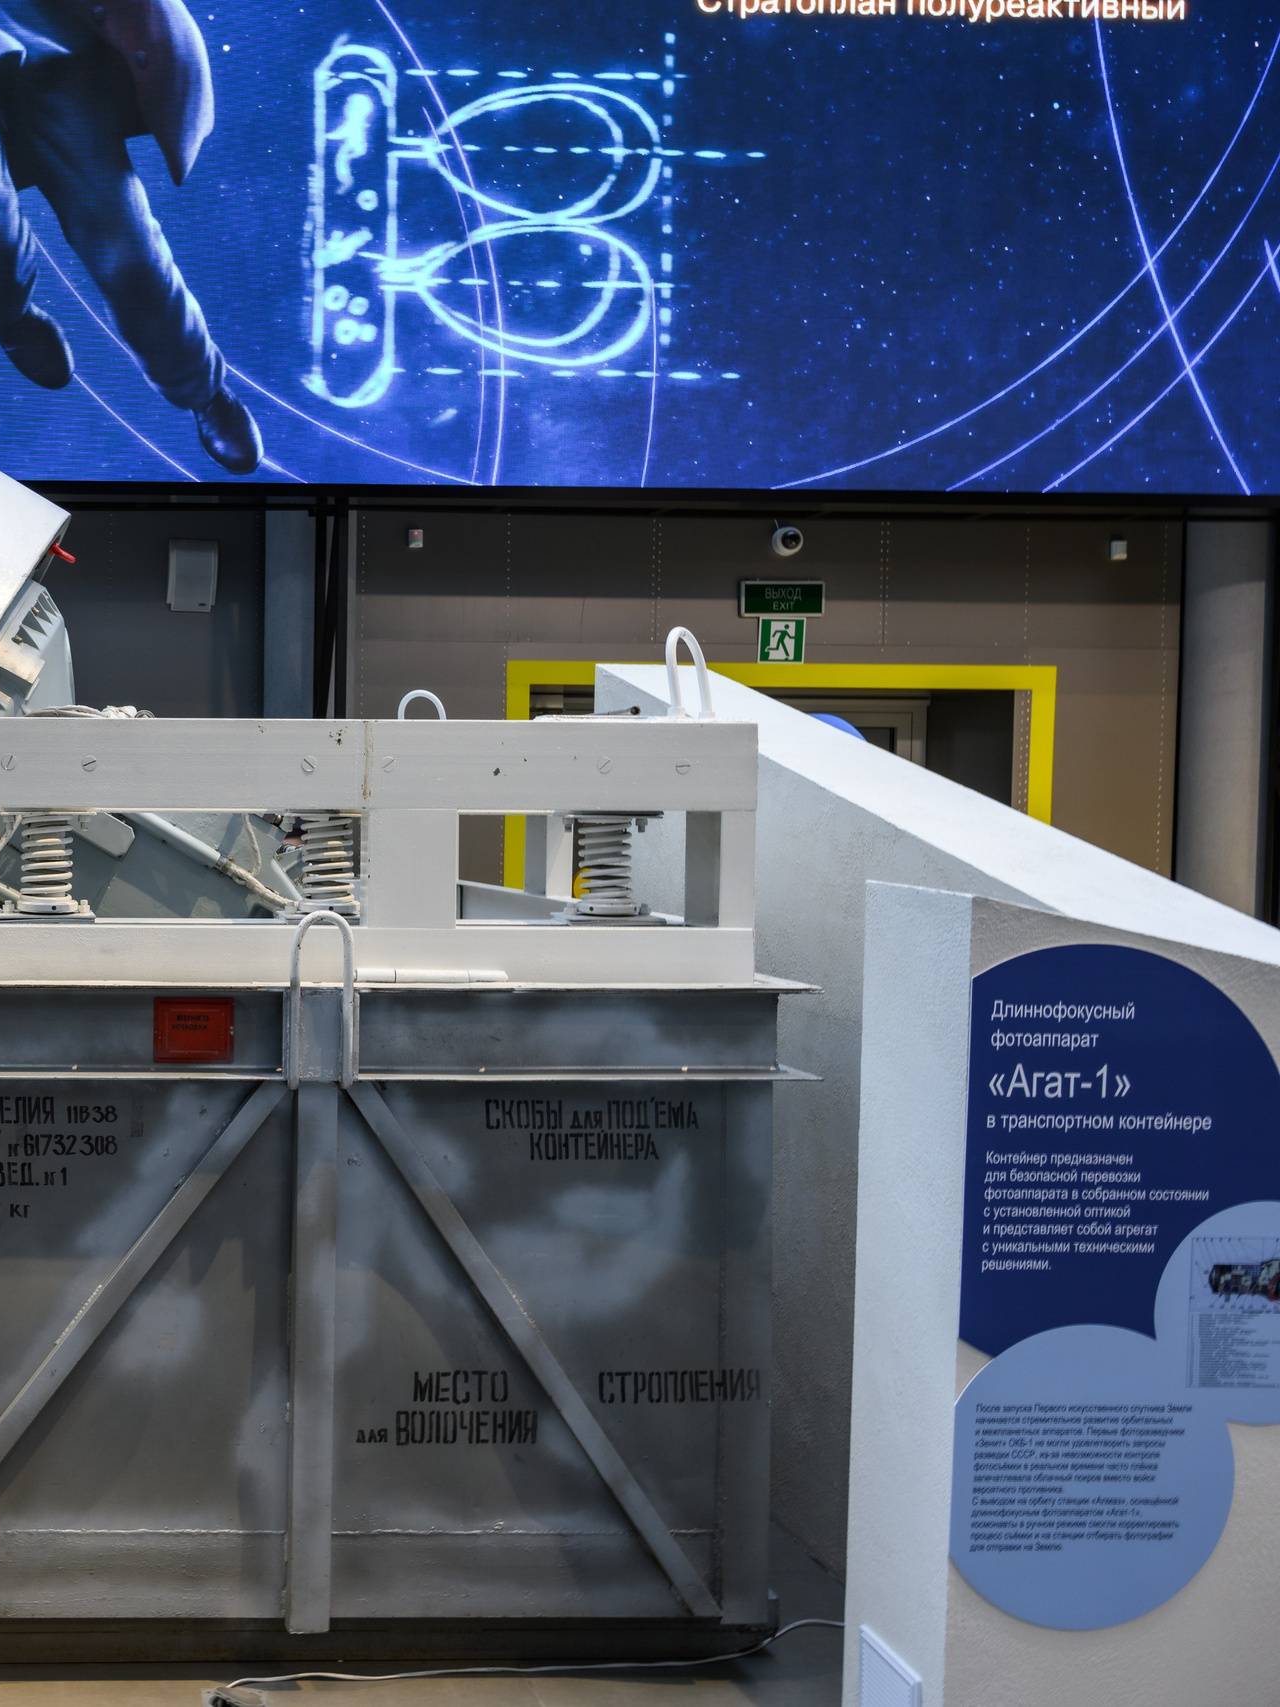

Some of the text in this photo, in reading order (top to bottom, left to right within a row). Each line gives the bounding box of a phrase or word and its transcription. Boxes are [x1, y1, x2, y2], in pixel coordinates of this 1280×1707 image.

[765, 587, 802, 601] ВЫХОД
[773, 602, 795, 611] EXIT
[991, 1000, 1135, 1023] Длиннофокусный
[990, 1029, 1099, 1051] фотоаппарат
[988, 1063, 1131, 1099] «Агат-1»
[485, 1098, 563, 1130] СКОБЫ
[986, 1112, 1212, 1134] в транспортном контейнере
[529, 1129, 660, 1161] КОНТЕЙНЕРА
[985, 1151, 1133, 1167] Контейнер предназначен
[984, 1169, 1141, 1185] для безопасной перевозки
[983, 1187, 1209, 1203] фотоаппарата в собранном состоянии
[9, 1203, 31, 1219] кг
[983, 1204, 1131, 1220] с установленной оптикой
[982, 1222, 1158, 1238] и представляет собой агрегат
[982, 1242, 1154, 1256] с уникальными техническими
[981, 1259, 1052, 1273] решениями.
[413, 1368, 760, 1404] МЕСТО СТРОПЛЕНИЯ
[395, 1410, 538, 1446] ВОЛОЧЕНИЯ
